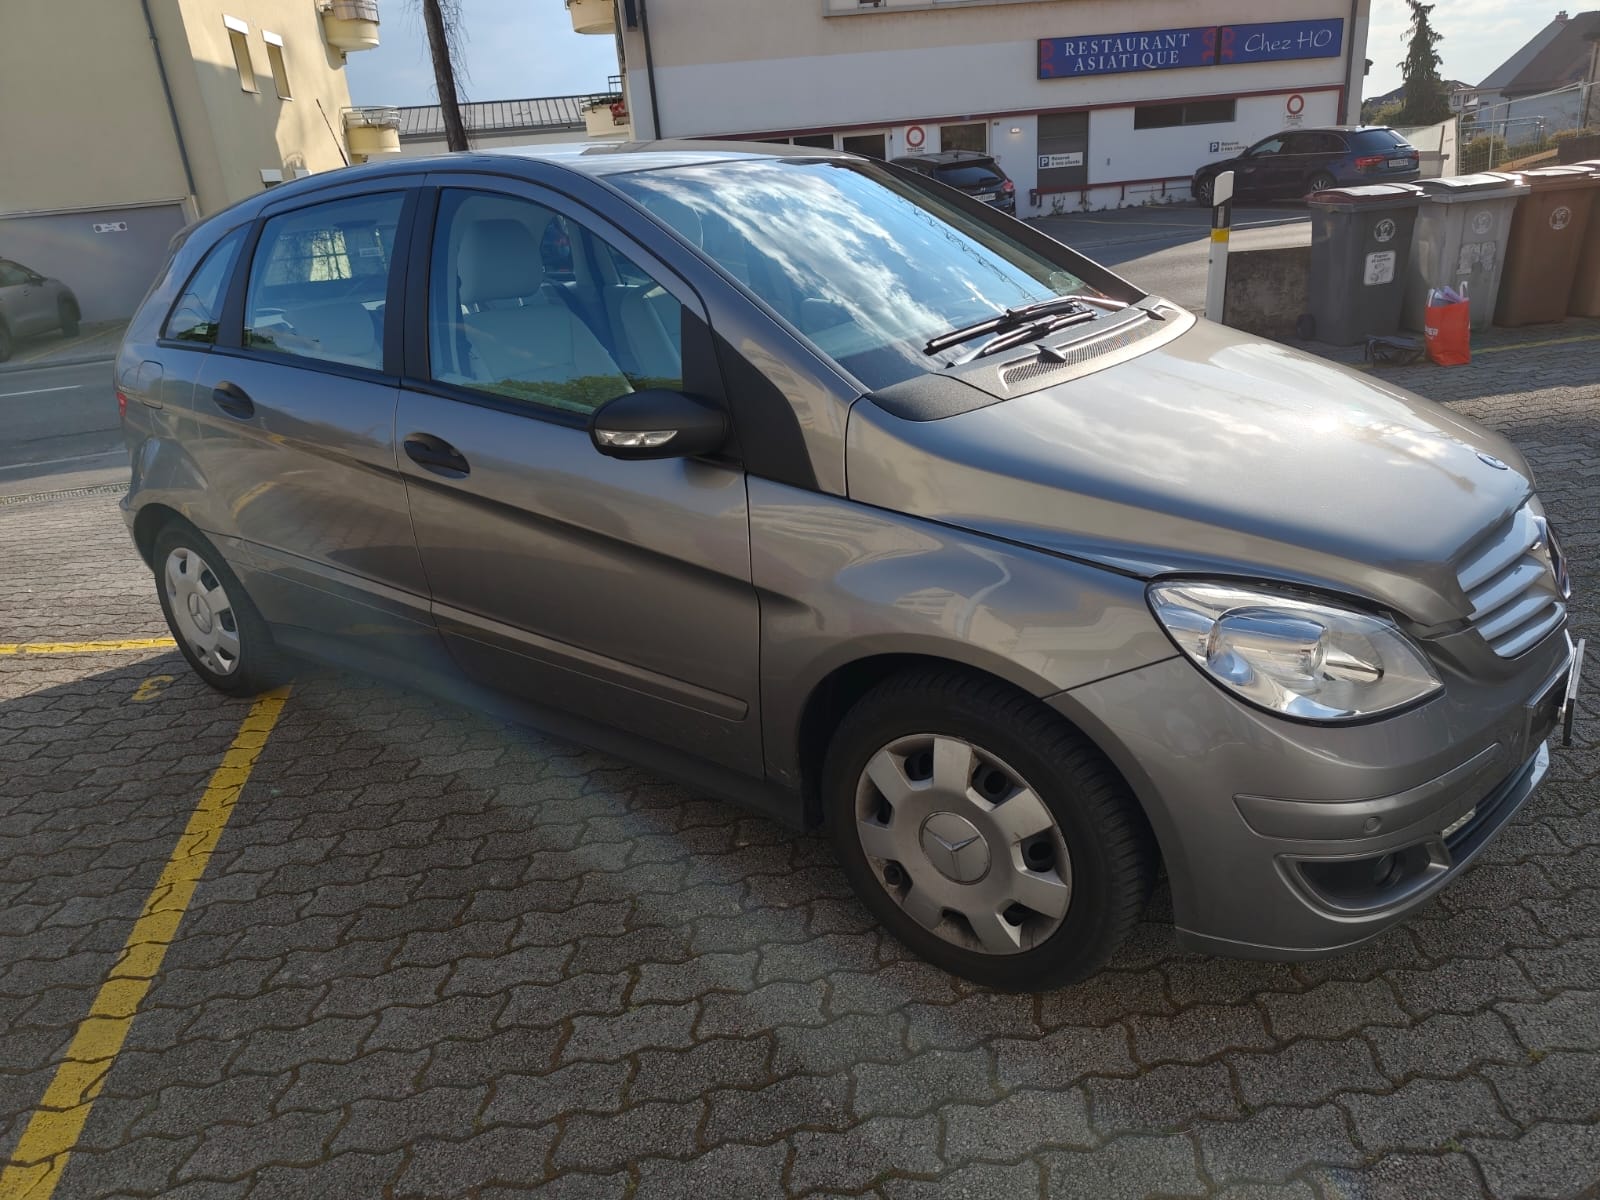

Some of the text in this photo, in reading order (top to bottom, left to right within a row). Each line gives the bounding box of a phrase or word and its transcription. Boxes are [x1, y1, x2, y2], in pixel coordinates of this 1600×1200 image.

[1065, 32, 1190, 56] RESTAURANT
[1244, 29, 1332, 53] Chez HO
[1074, 50, 1180, 71] ASIATIQUE
